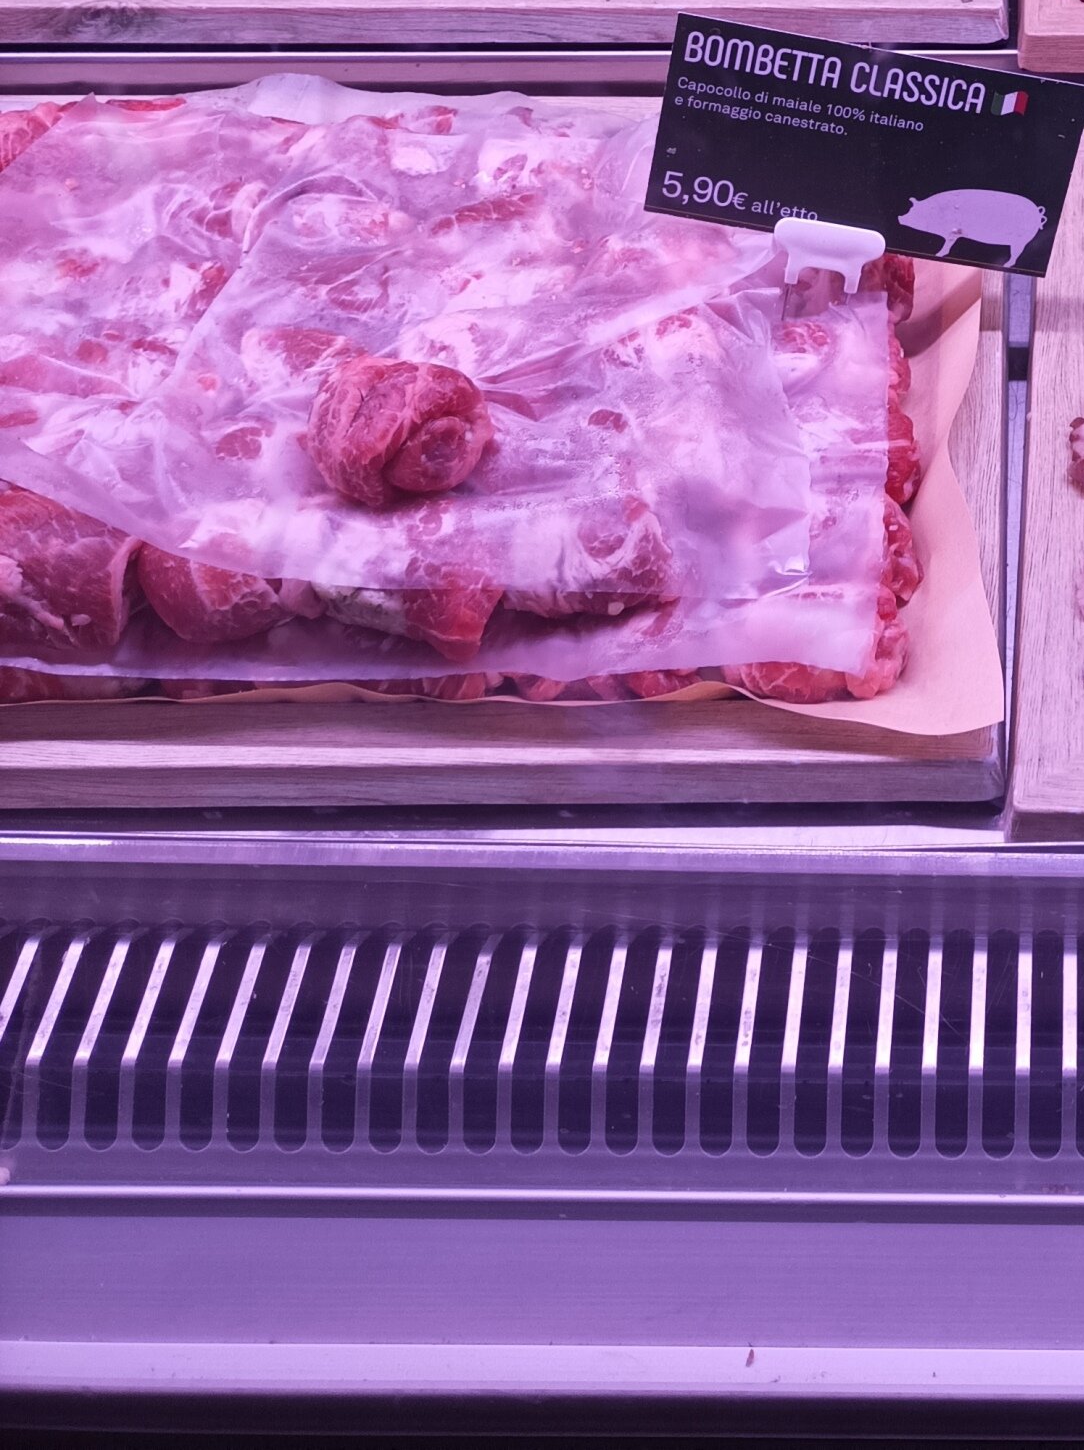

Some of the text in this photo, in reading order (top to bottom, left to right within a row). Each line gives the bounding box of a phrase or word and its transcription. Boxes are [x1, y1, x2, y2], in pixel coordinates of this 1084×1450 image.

[684, 31, 986, 114] BOMBETTA CLASSICA
[674, 95, 848, 135] e formaggio canestrato.
[677, 76, 924, 131] Capocollo di maiale 100% italiano
[662, 170, 748, 210] 5,90€
